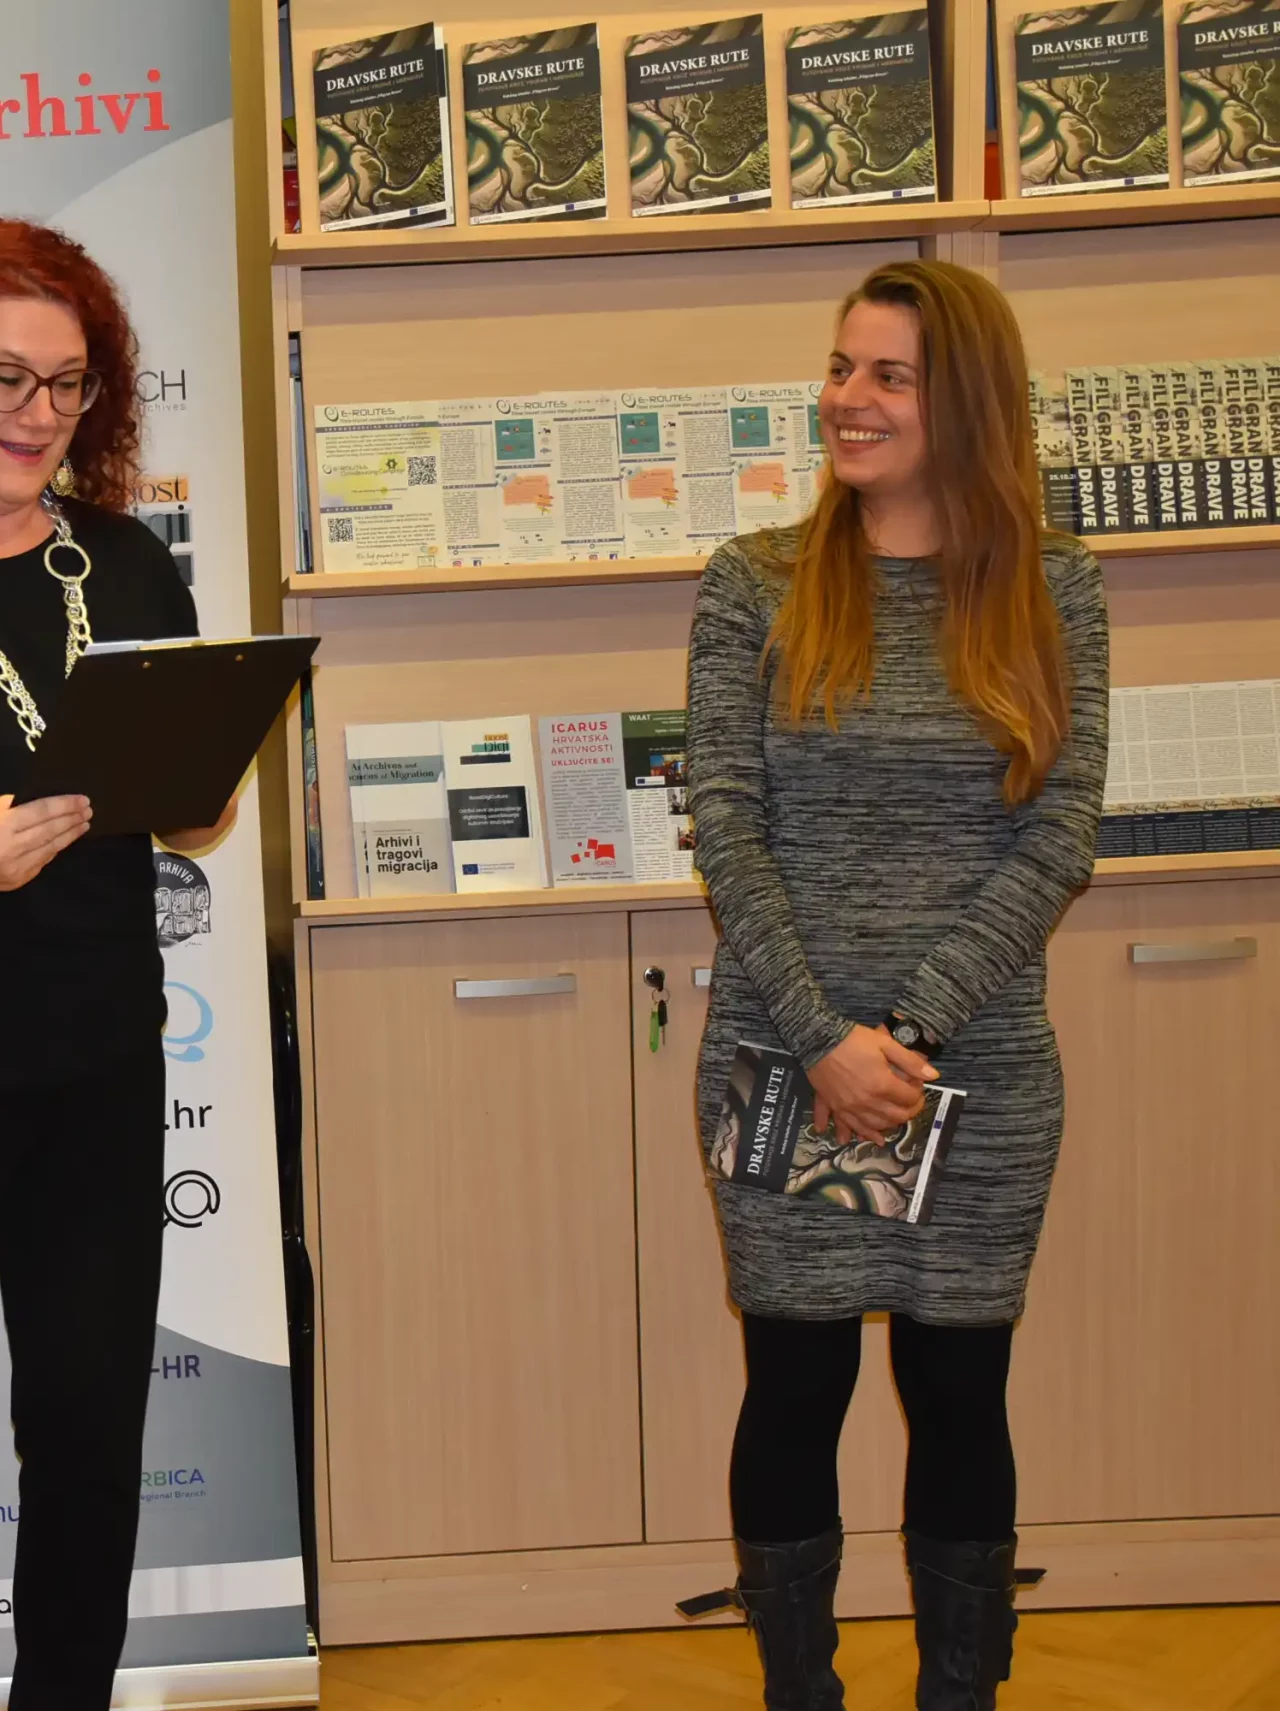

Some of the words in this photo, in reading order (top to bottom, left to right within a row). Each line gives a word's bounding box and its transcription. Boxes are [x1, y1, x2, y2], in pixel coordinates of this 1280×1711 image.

[801, 50, 870, 69] DRAVSKE
[874, 44, 914, 59] RUTE
[1032, 36, 1103, 56] DRAVSKE
[1107, 30, 1148, 46] RUTE
[1194, 22, 1269, 45] DRAVSKE
[326, 68, 387, 92] DRAVSKE
[390, 59, 425, 77] RUTE
[477, 65, 543, 85] DRAVSKE
[547, 58, 584, 74] RUTE
[640, 55, 707, 78] DRAVSKE
[710, 49, 749, 66] RUTE
[135, 369, 186, 401] CH
[341, 407, 395, 417] E-ROUTES
[1070, 378, 1091, 464] FILIGRAN
[1094, 376, 1114, 462] FILIGRAN
[1125, 375, 1143, 460] FILIGRAN
[1151, 373, 1170, 458] FILIGRAN
[1171, 372, 1192, 457] FILIGRAN
[1198, 370, 1219, 455] FILIGRAN
[1225, 369, 1244, 454] FILIGRAN
[1242, 368, 1262, 453] FILIGRAN
[1078, 468, 1097, 528] DRAVE
[1101, 467, 1119, 527] DRAVE
[1131, 465, 1149, 525] DRAVE
[1158, 463, 1177, 523] DRAVE
[1178, 462, 1197, 523] DRAVE
[1205, 460, 1224, 521] DRAVE
[1231, 459, 1249, 520] DRAVE
[1248, 458, 1267, 519] DRAVE
[551, 721, 608, 733] ICARUS
[551, 744, 613, 755] AKTIVNOSTI
[552, 734, 609, 744] HRVATSKA
[363, 762, 402, 771] Archives
[390, 769, 434, 780] Migration
[376, 836, 413, 849] Arhivi
[376, 848, 423, 861] tragovi
[159, 861, 195, 885] ARHIVA
[378, 860, 438, 875] migracija
[747, 1106, 775, 1175] DRAVSKE
[765, 1066, 785, 1106] RUTE
